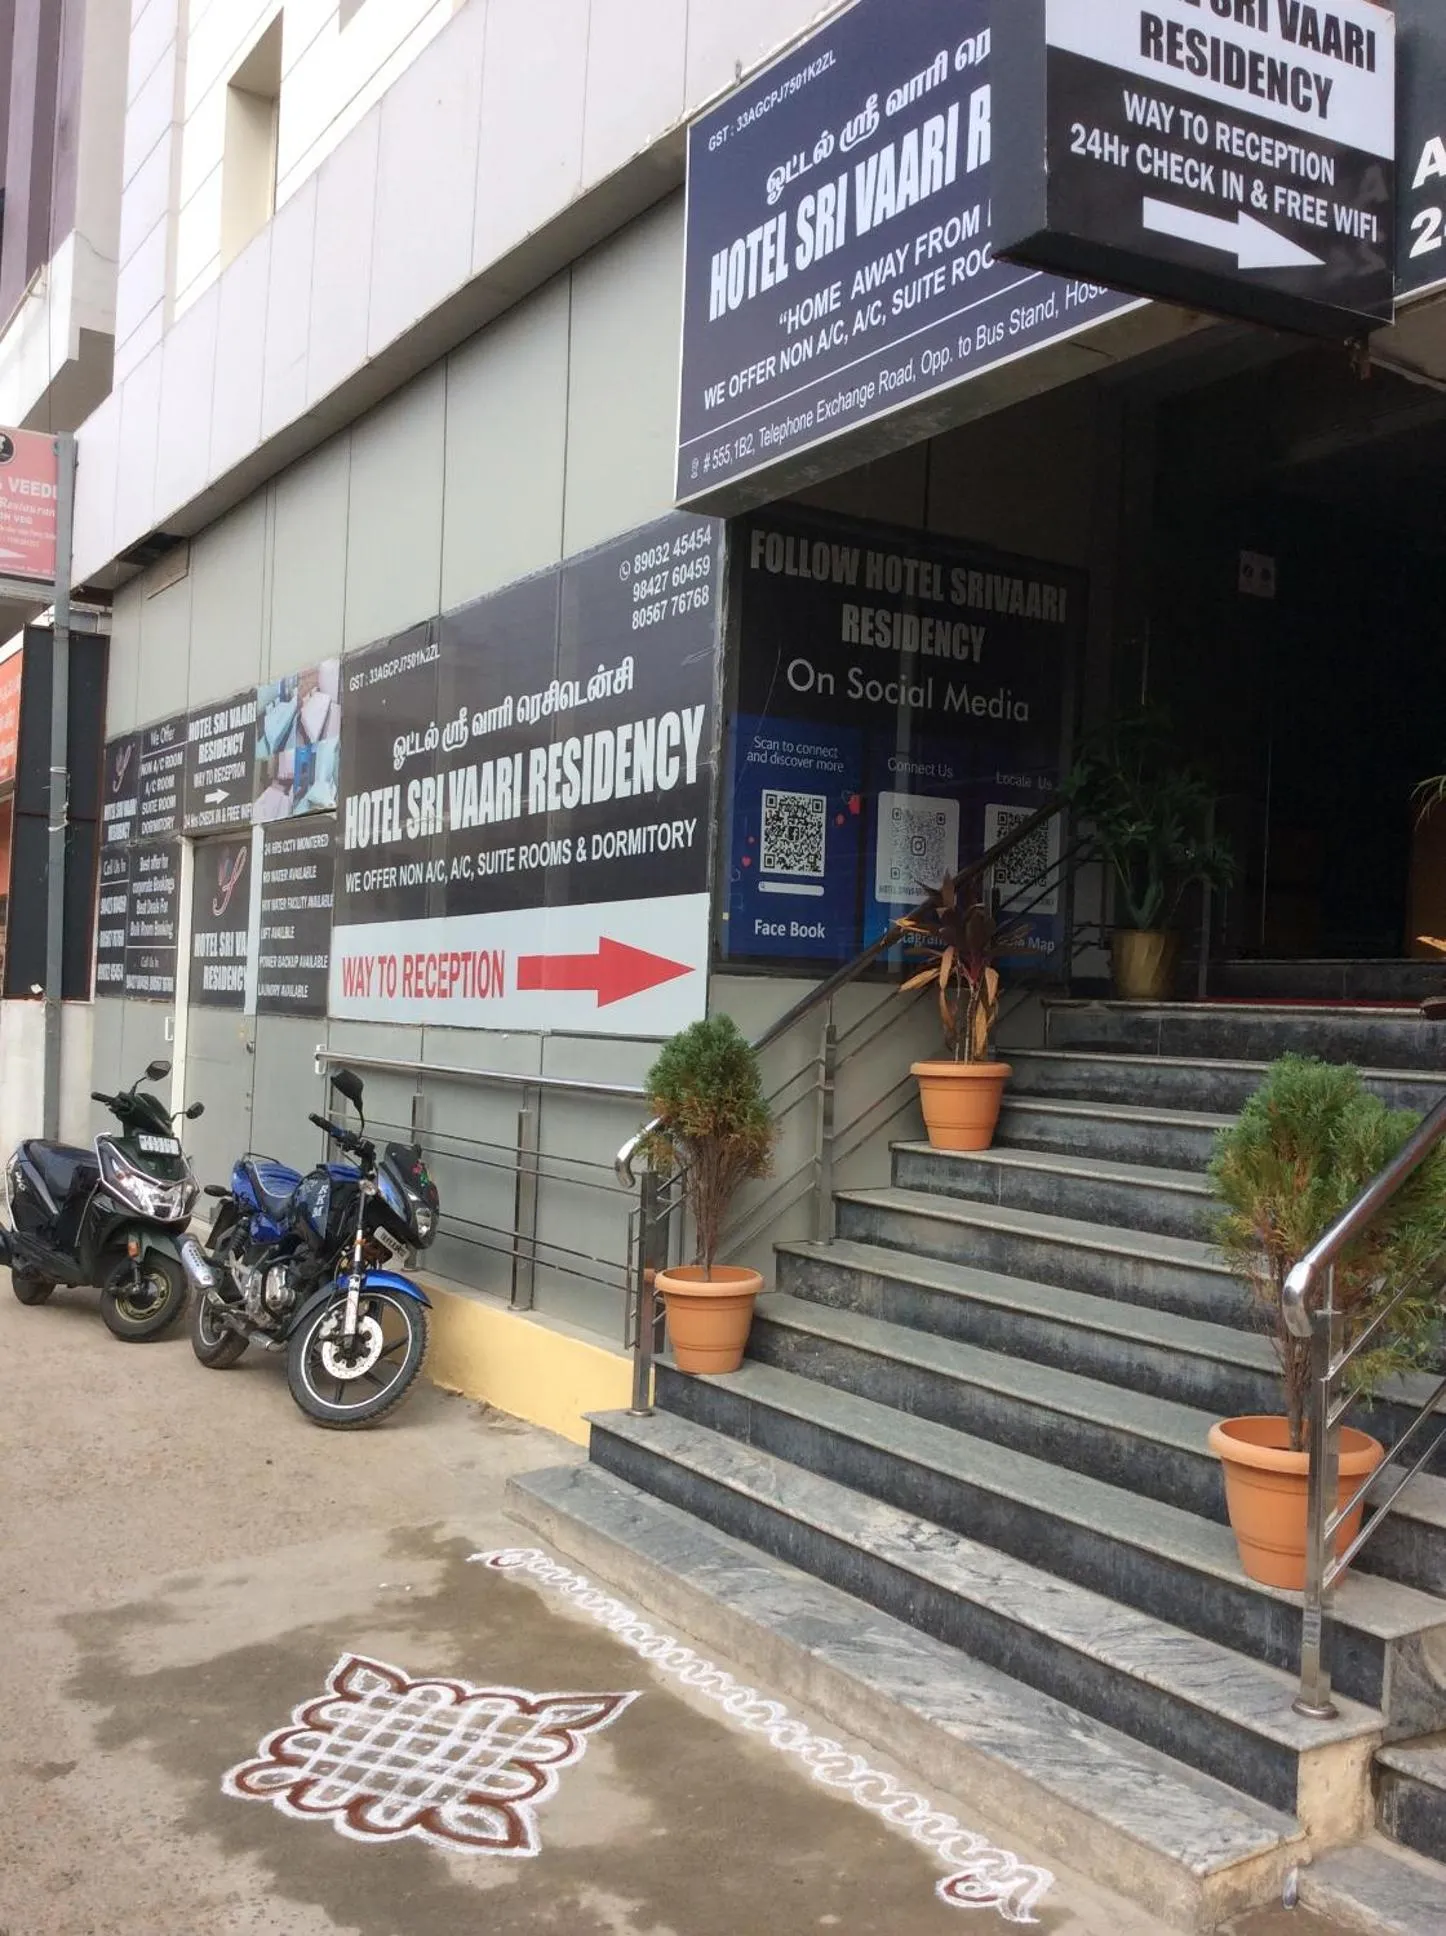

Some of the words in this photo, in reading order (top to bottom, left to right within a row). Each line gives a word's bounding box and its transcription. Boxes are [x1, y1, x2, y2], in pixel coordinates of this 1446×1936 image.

[1278, 0, 1376, 72] VAARI
[1140, 10, 1333, 120] RESIDENCY
[708, 127, 729, 151] GST
[1123, 89, 1176, 134] WAY
[1179, 108, 1209, 145] TO
[1215, 122, 1335, 187] RECEPTION
[1070, 123, 1130, 169] 24Hr
[1136, 143, 1215, 195] CHECK
[1222, 169, 1244, 203] IN
[1250, 178, 1268, 210] &
[1274, 185, 1328, 229] FREE
[1334, 203, 1378, 243] WIFI
[709, 212, 788, 322] HOTEL
[796, 172, 848, 271] SRI
[855, 102, 960, 237] VAARI
[851, 244, 909, 299] AWAY
[915, 205, 981, 265] FROM
[704, 382, 725, 410] WE
[729, 356, 776, 400] OFFER
[780, 336, 813, 374] NON
[816, 321, 849, 354] A/C,
[852, 300, 886, 336] A/C,
[891, 266, 945, 315] SUITE
[759, 409, 813, 448] Telephone
[817, 379, 875, 423] Exchange
[878, 361, 917, 395] Road,
[921, 349, 952, 376] Opp.
[958, 336, 971, 360] to
[976, 322, 1004, 351] Bus
[1009, 292, 1059, 335] Stand,
[634, 542, 670, 574] 89032
[672, 524, 712, 557] 45454
[750, 529, 860, 586] FOLLOW
[865, 551, 945, 601] HOTEL
[633, 571, 669, 602] 98427
[672, 555, 711, 587] 60459
[632, 599, 668, 630] 80567
[671, 585, 710, 616] 76768
[841, 603, 988, 664] RESIDENCY
[349, 672, 364, 692] GST
[787, 657, 835, 696] On
[847, 666, 934, 710] Social
[943, 682, 1031, 723] Media
[188, 716, 212, 741] HOTEL
[213, 710, 228, 734] SRI
[230, 701, 257, 729] VAARI
[140, 761, 153, 776] NON
[165, 752, 183, 769] ROOM
[198, 731, 245, 764] RESIDENCY
[746, 750, 768, 764] and
[769, 752, 815, 769] discover
[816, 759, 845, 773] more
[753, 735, 780, 751] Scan
[782, 741, 794, 752] to
[796, 743, 839, 759] connect
[887, 757, 936, 776] Connect
[937, 763, 954, 779] Us
[157, 774, 175, 792] ROOM
[213, 761, 246, 784] RECEPTION
[344, 784, 403, 850] HOTEL
[407, 770, 444, 841] SRI
[449, 752, 523, 831] VAARI
[528, 704, 706, 815] RESIDENCY
[158, 795, 176, 812] ROOM
[345, 870, 361, 893] WE
[363, 865, 397, 891] OFFER
[399, 862, 424, 886] NON
[425, 857, 448, 885] A/C,
[450, 853, 475, 882] A/C,
[477, 848, 515, 877] SUITE
[518, 839, 572, 869] ROOMS
[575, 836, 587, 861] &
[591, 817, 698, 860] DORMITORY
[194, 932, 218, 957] HOTEL
[220, 931, 234, 957] SRI
[754, 919, 787, 937] Face
[790, 919, 826, 940] Book
[203, 965, 246, 991] RESIDENC
[341, 955, 373, 998] WAY
[377, 954, 397, 998] TO
[402, 949, 506, 999] RECEPTION
